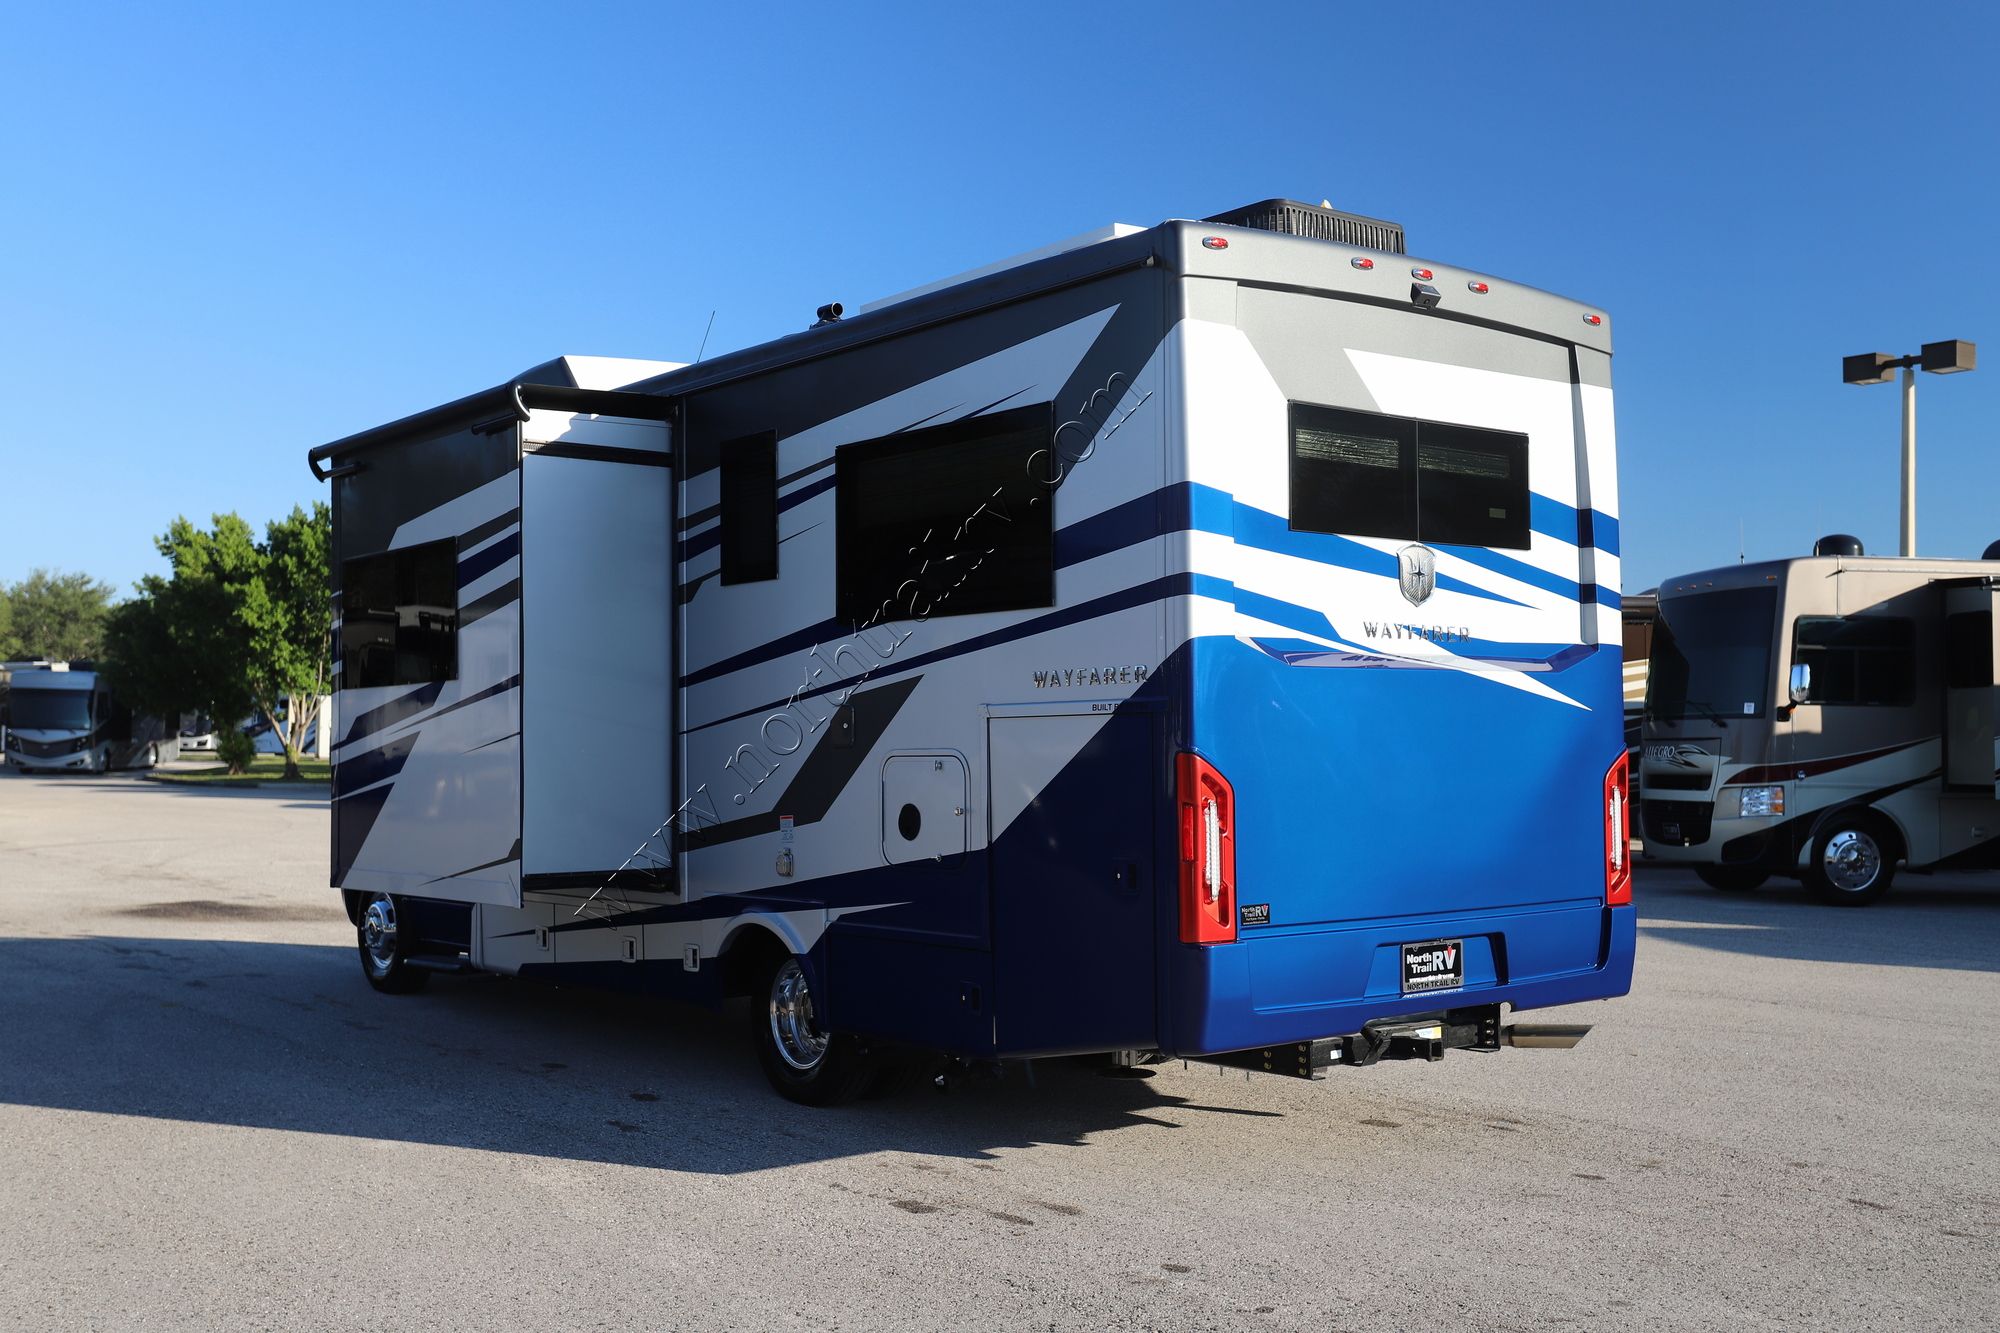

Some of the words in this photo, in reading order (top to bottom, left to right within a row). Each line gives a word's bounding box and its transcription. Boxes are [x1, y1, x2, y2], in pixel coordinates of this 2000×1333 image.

[1363, 621, 1471, 642] WAYFARER
[1032, 664, 1149, 688] WAYFARER
[1092, 704, 1113, 712] BUILT
[1255, 905, 1268, 917] RV
[1406, 952, 1432, 964] North
[1432, 948, 1456, 972] RV
[1411, 963, 1432, 974] Trail
[1406, 982, 1429, 991] NORTH
[1430, 980, 1450, 988] TRAIL
[1450, 978, 1460, 986] RV
